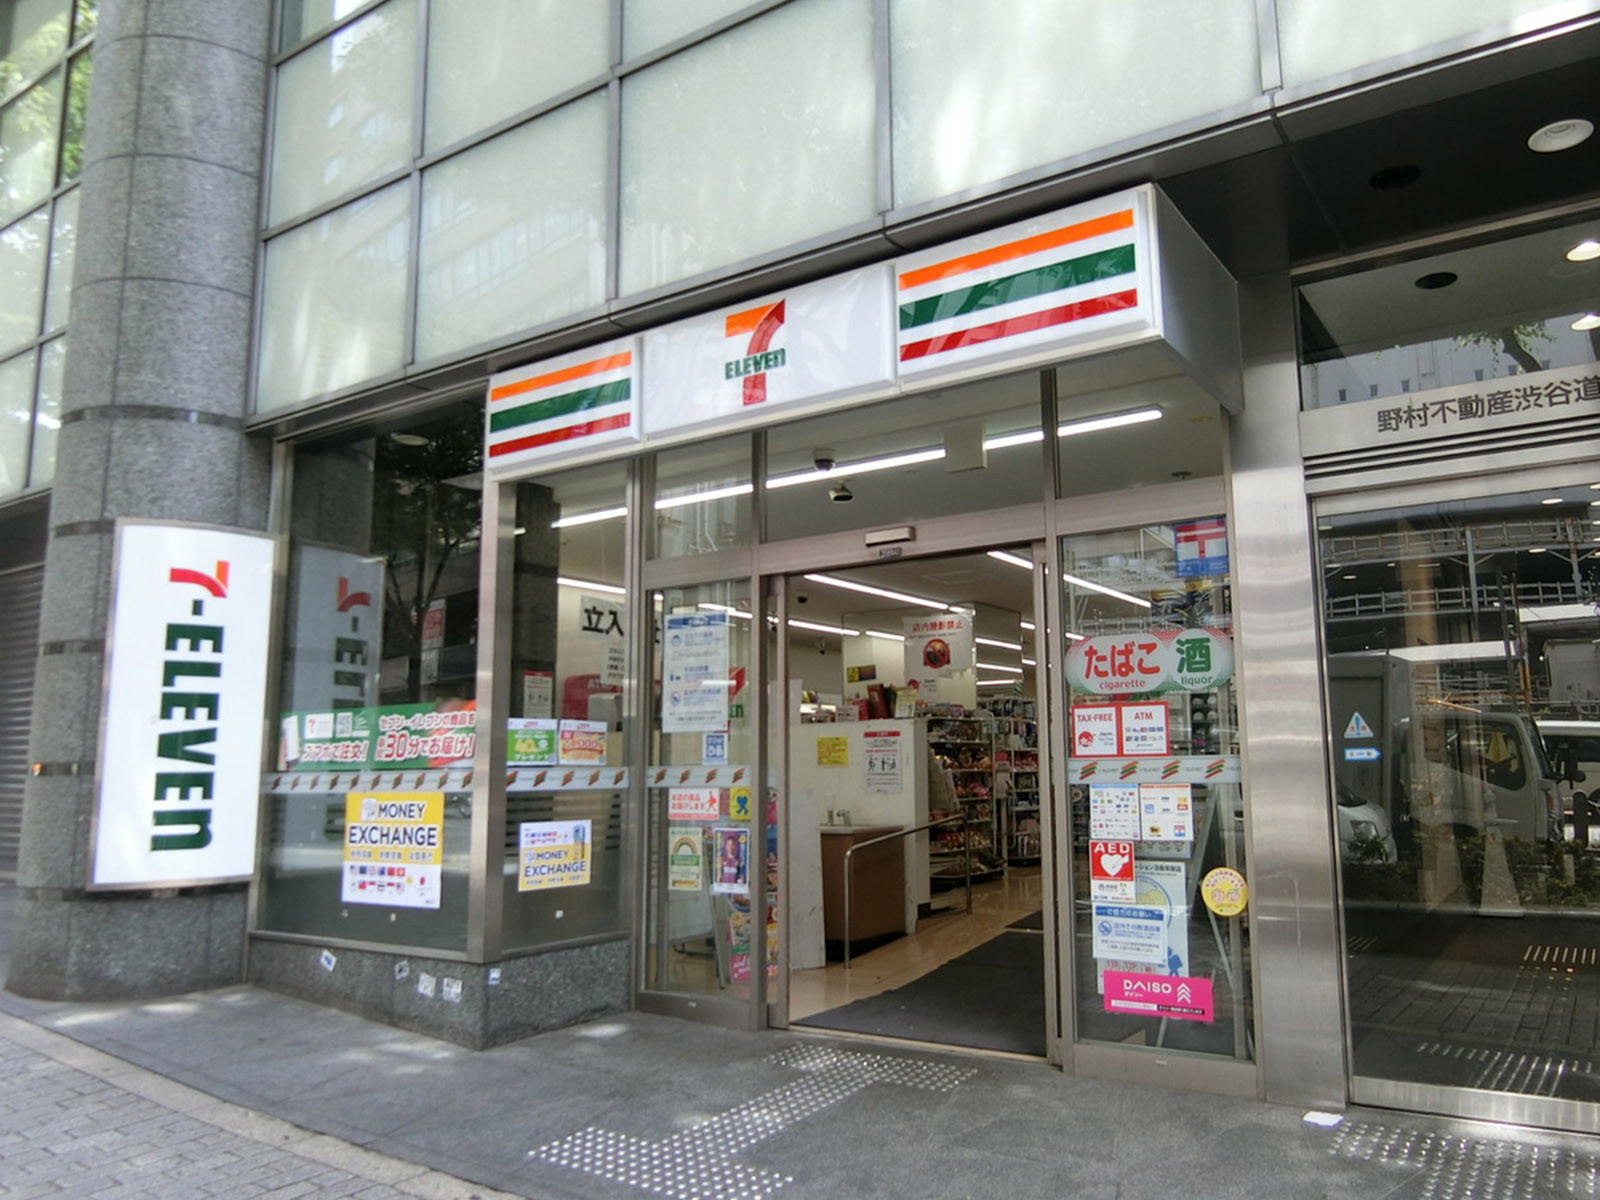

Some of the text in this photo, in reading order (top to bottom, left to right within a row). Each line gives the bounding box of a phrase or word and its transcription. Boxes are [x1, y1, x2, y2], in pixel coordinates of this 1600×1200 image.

[1377, 374, 1600, 433] 野村不動産渋谷道
[1083, 636, 1212, 679] たばこ 酒
[1098, 674, 1214, 690] cigarette liquor
[1076, 712, 1114, 723] TAX-FREE
[1133, 711, 1154, 721] ATM
[378, 803, 426, 819] MONEY
[348, 825, 437, 847] EXCHANGE
[536, 849, 569, 861] MONEY
[1093, 842, 1130, 854] AED
[524, 860, 587, 878] EXCHANGE
[1123, 979, 1172, 994] DAISO
